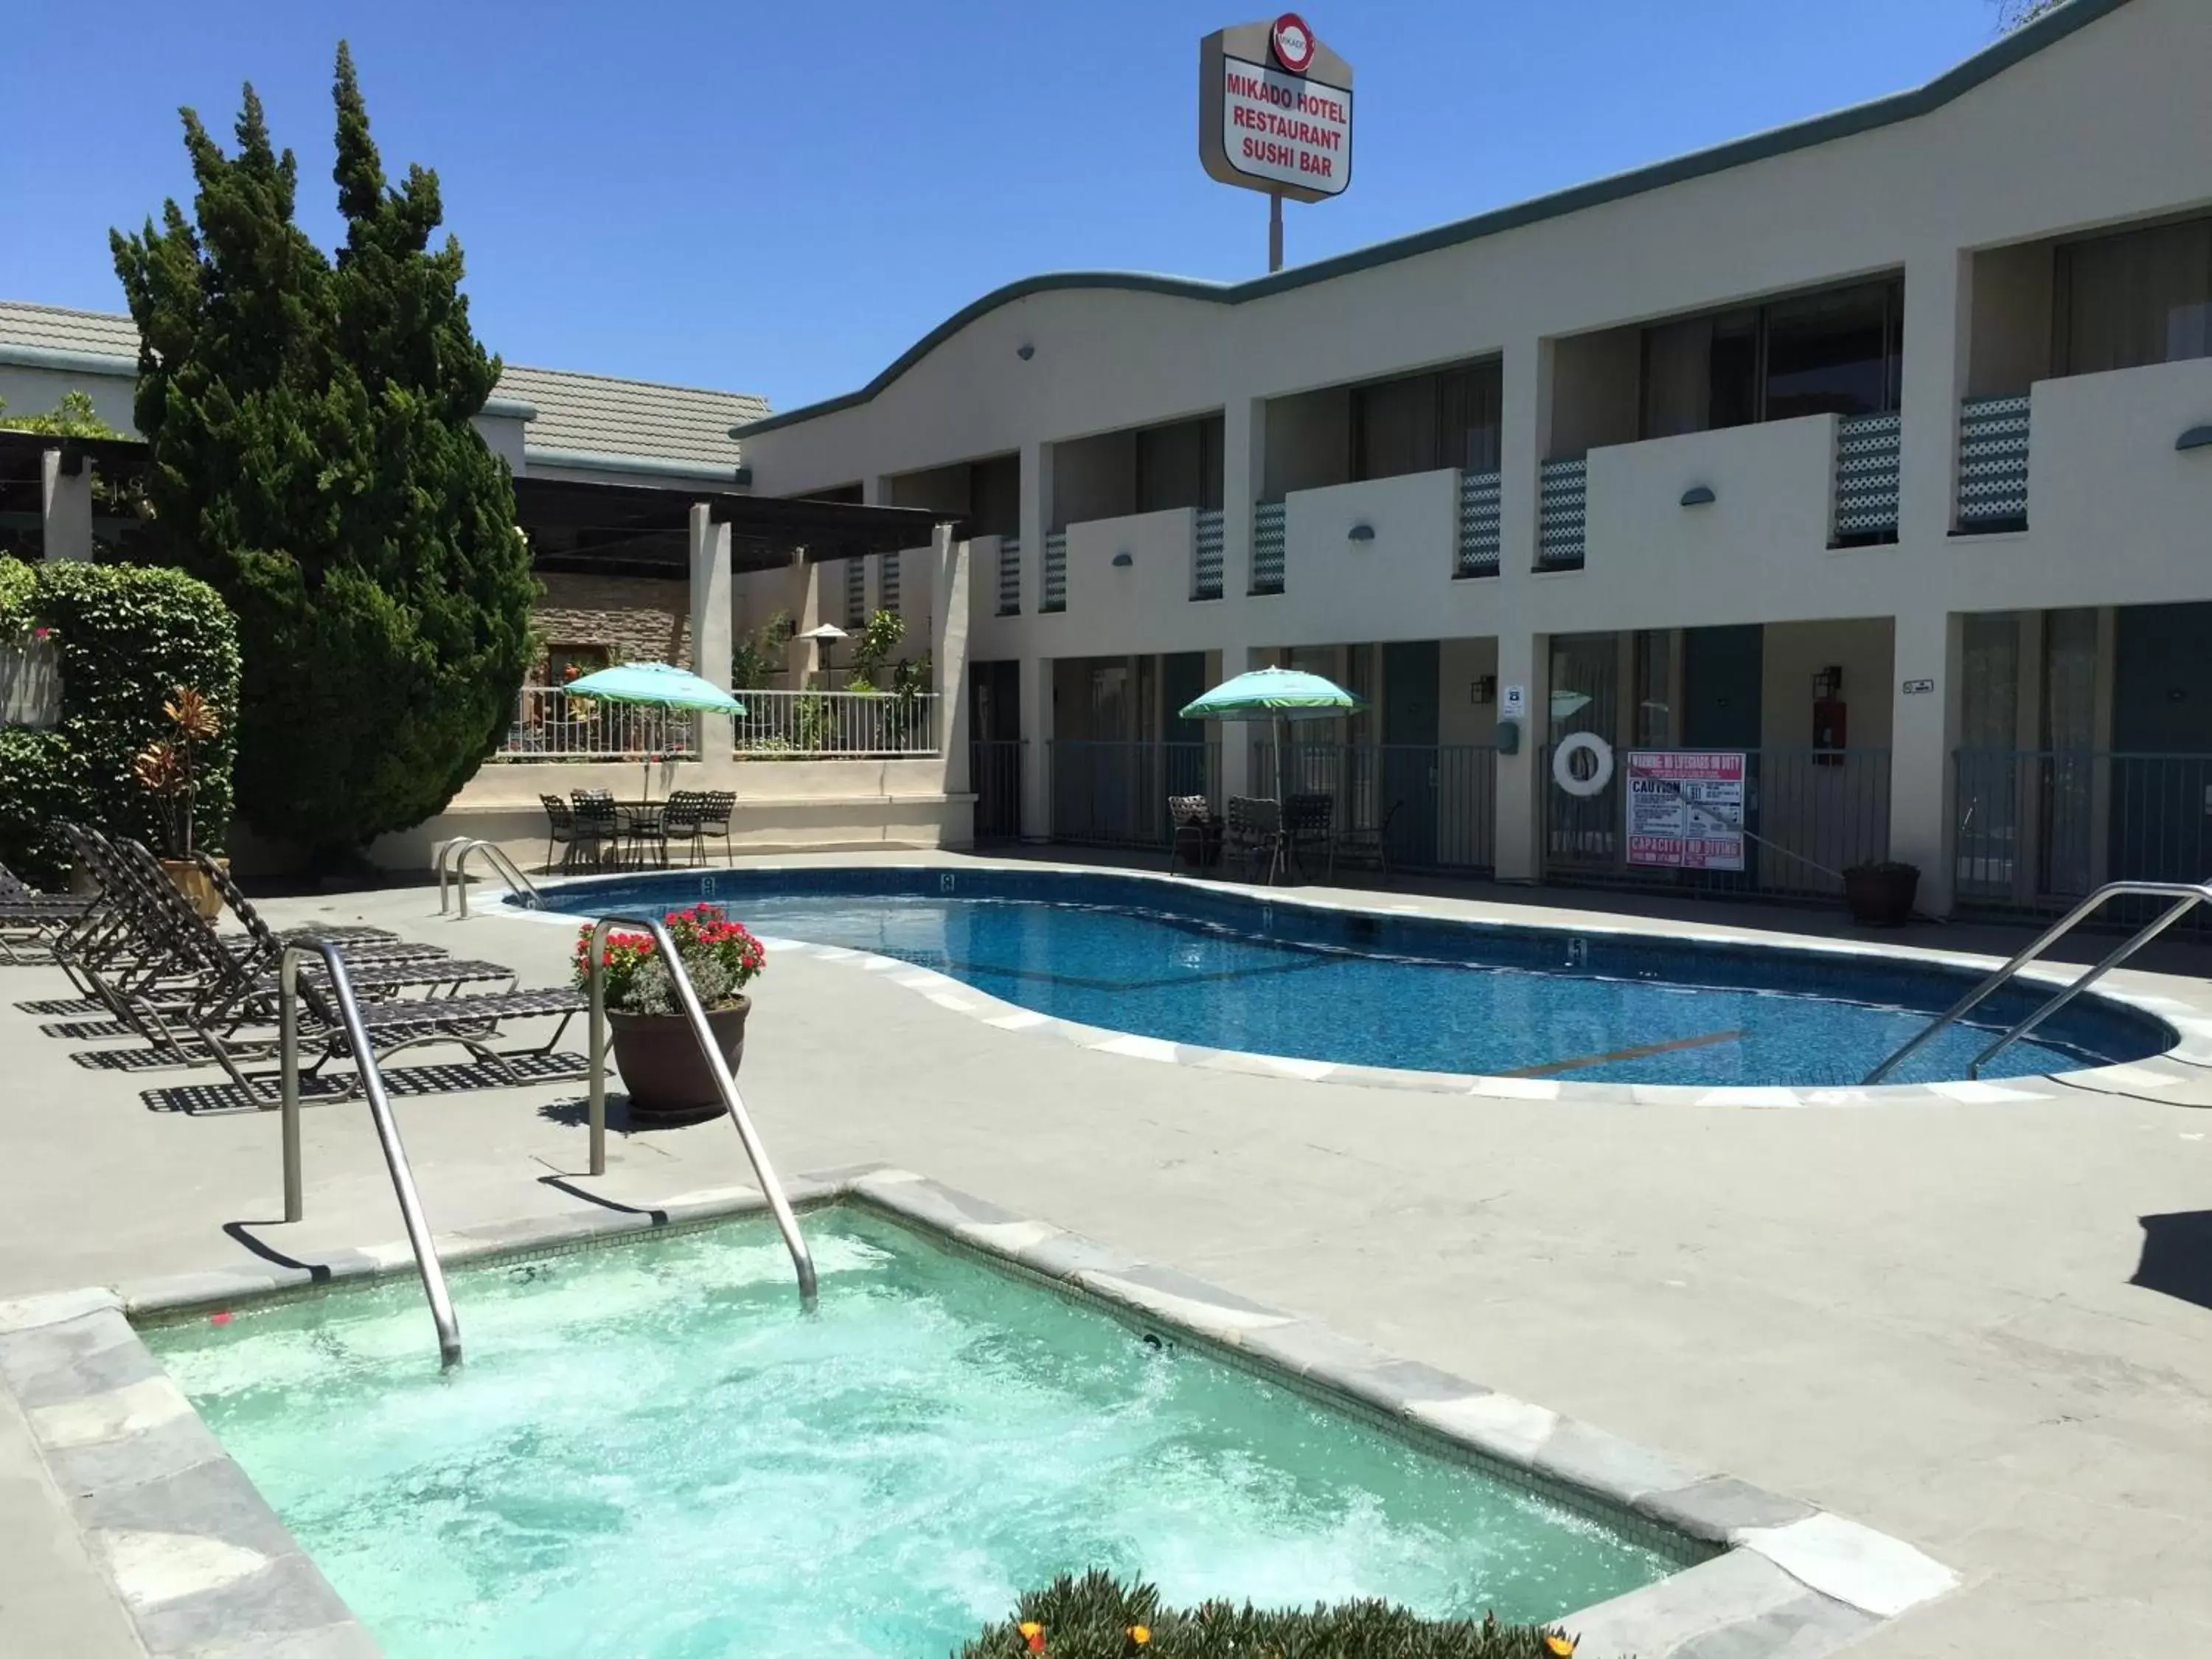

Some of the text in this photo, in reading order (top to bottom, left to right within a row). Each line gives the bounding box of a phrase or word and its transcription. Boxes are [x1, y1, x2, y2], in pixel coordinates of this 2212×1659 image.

[1227, 73, 1346, 125] MIKADO HOTEL
[1234, 105, 1340, 152] RESTAURANT
[1242, 137, 1332, 177] SUSHI BAR
[1633, 782, 1680, 793] CAUTION
[1632, 837, 1682, 852] CAPACITY
[1688, 841, 1739, 855] NO DIVING
